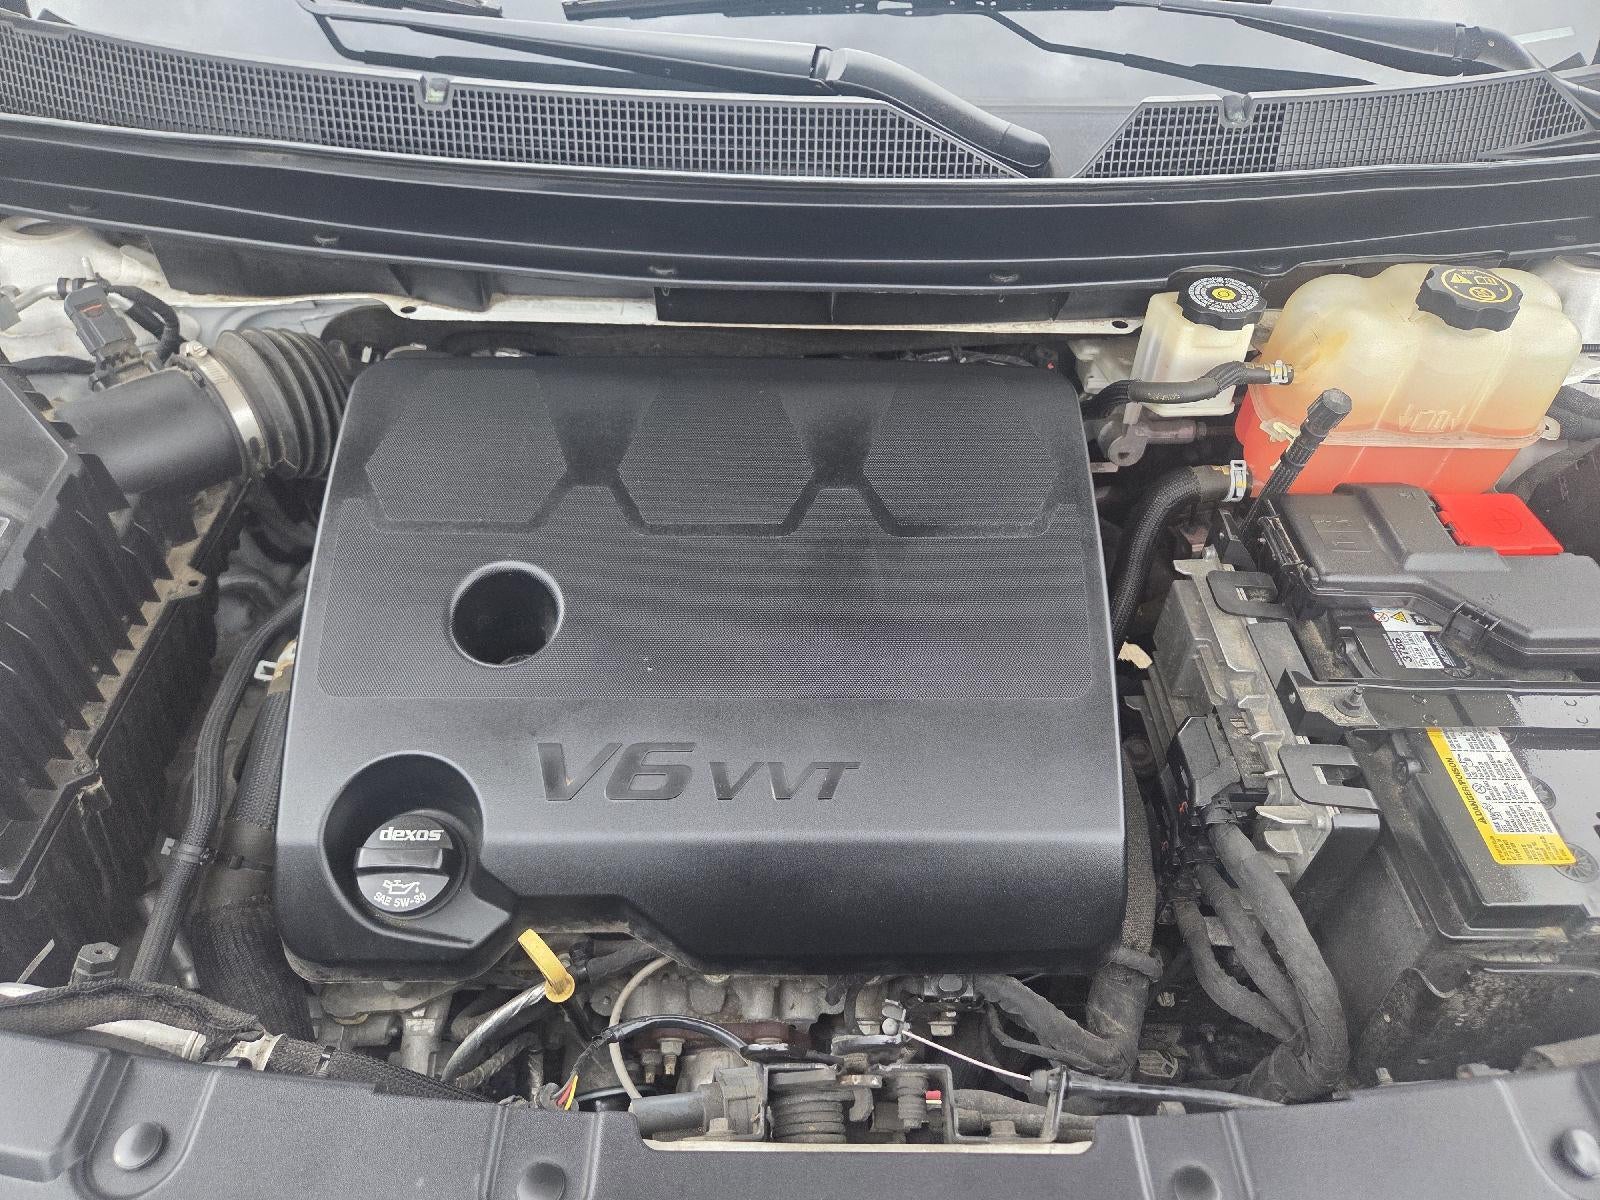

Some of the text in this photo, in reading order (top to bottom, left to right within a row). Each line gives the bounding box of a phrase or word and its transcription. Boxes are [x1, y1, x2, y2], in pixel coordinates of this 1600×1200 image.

[538, 742, 861, 801] V6 VVT
[379, 826, 444, 842] dexos
[373, 891, 392, 906] SAE
